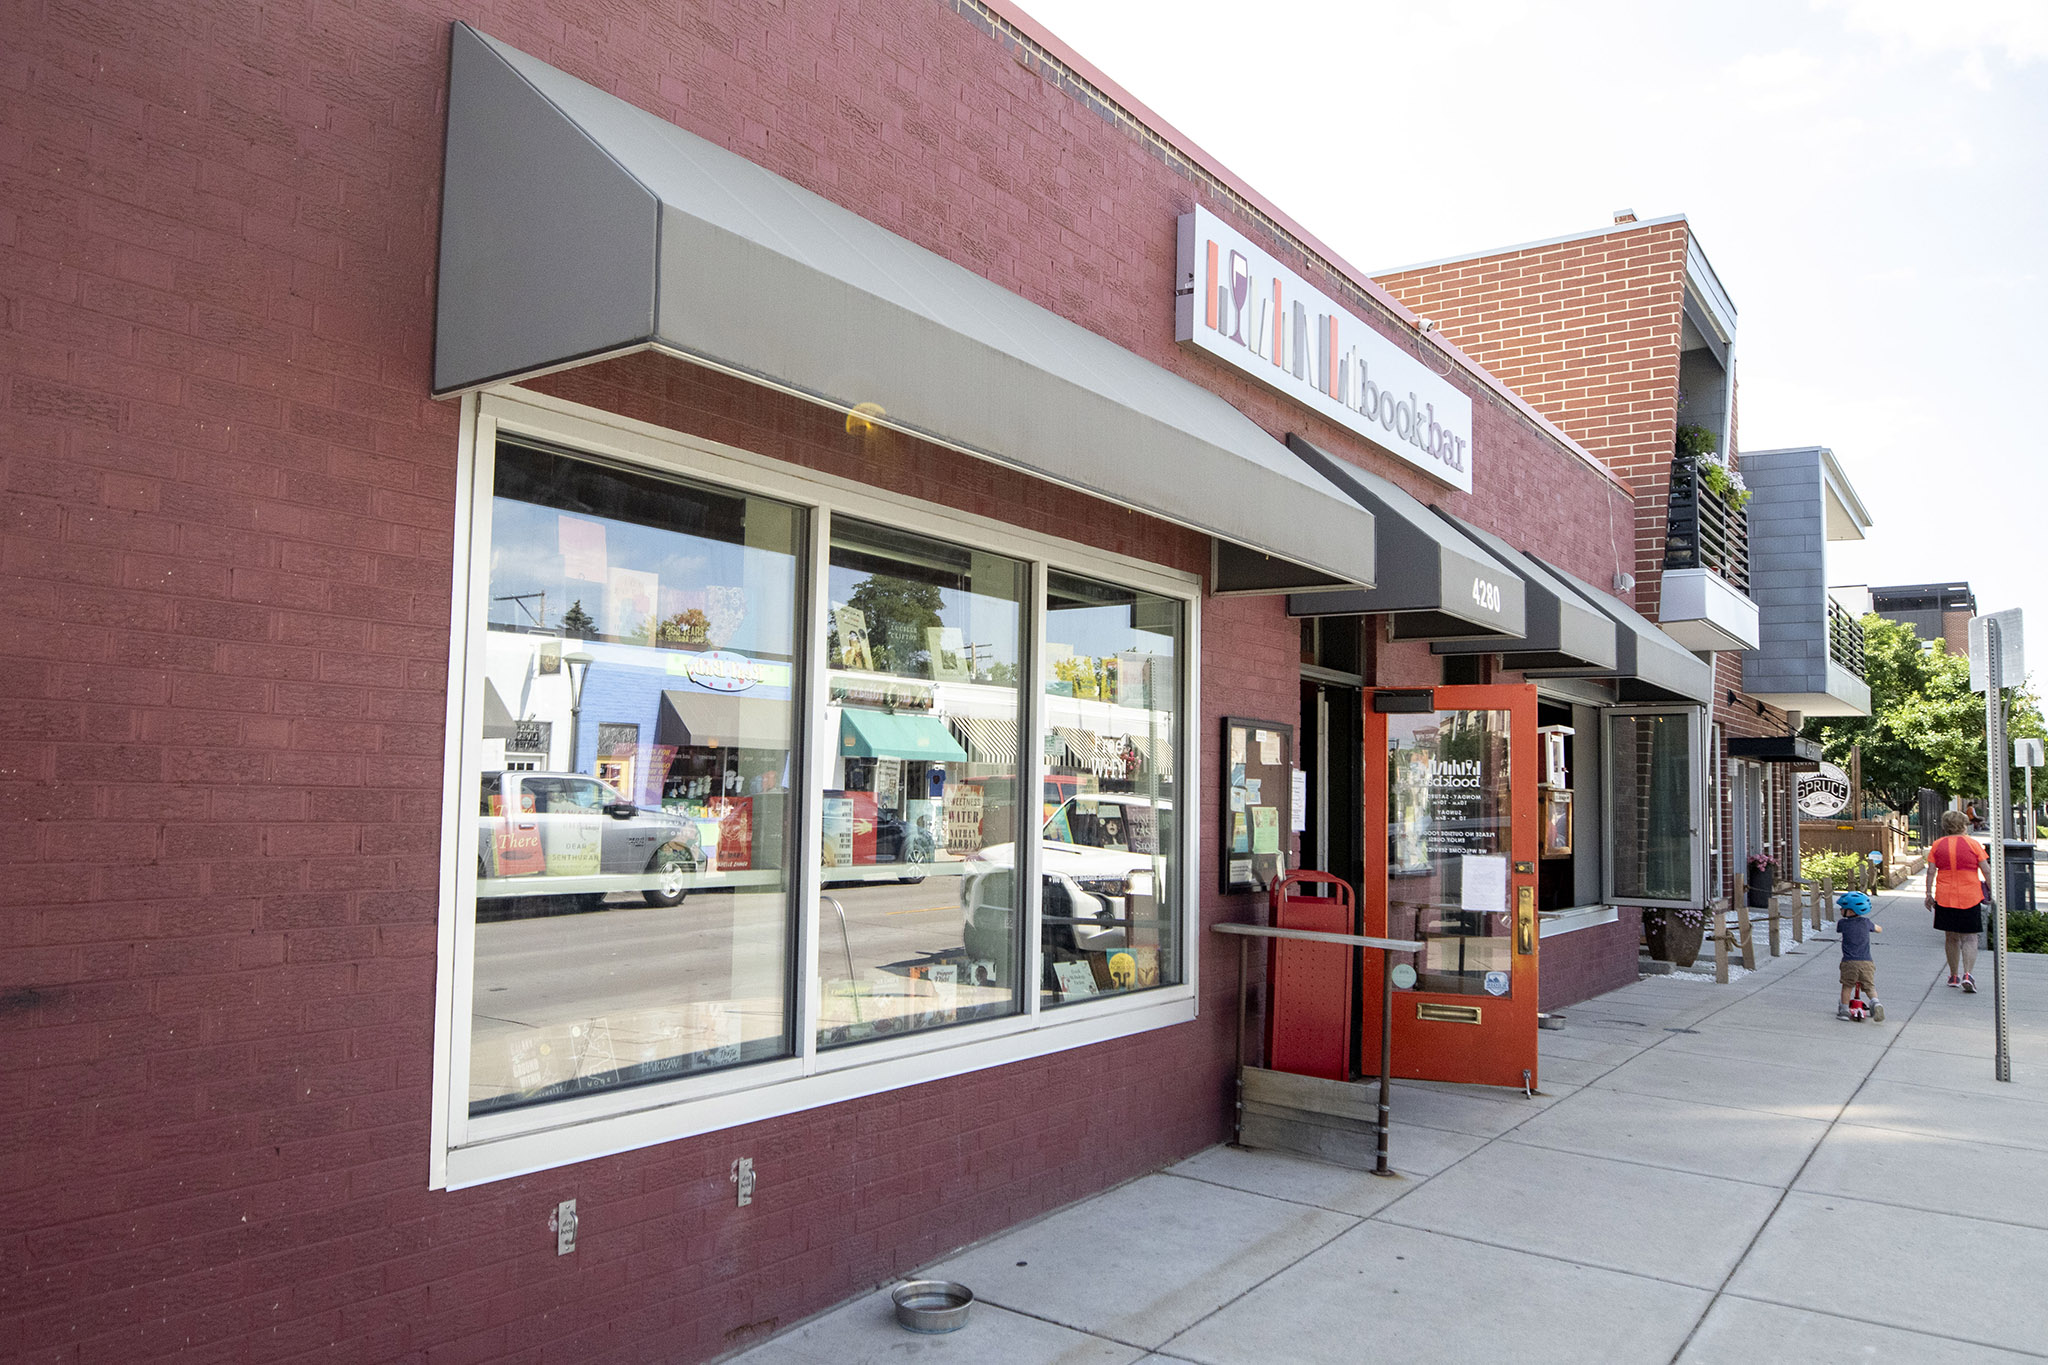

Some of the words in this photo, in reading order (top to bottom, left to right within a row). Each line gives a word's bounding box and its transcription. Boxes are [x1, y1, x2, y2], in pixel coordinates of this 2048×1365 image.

[1360, 359, 1466, 473] bookbar
[1472, 577, 1501, 613] 4280
[1797, 780, 1848, 800] SPRUCE
[948, 811, 979, 823] WATER
[498, 833, 540, 849] There
[565, 842, 587, 850] DEAR
